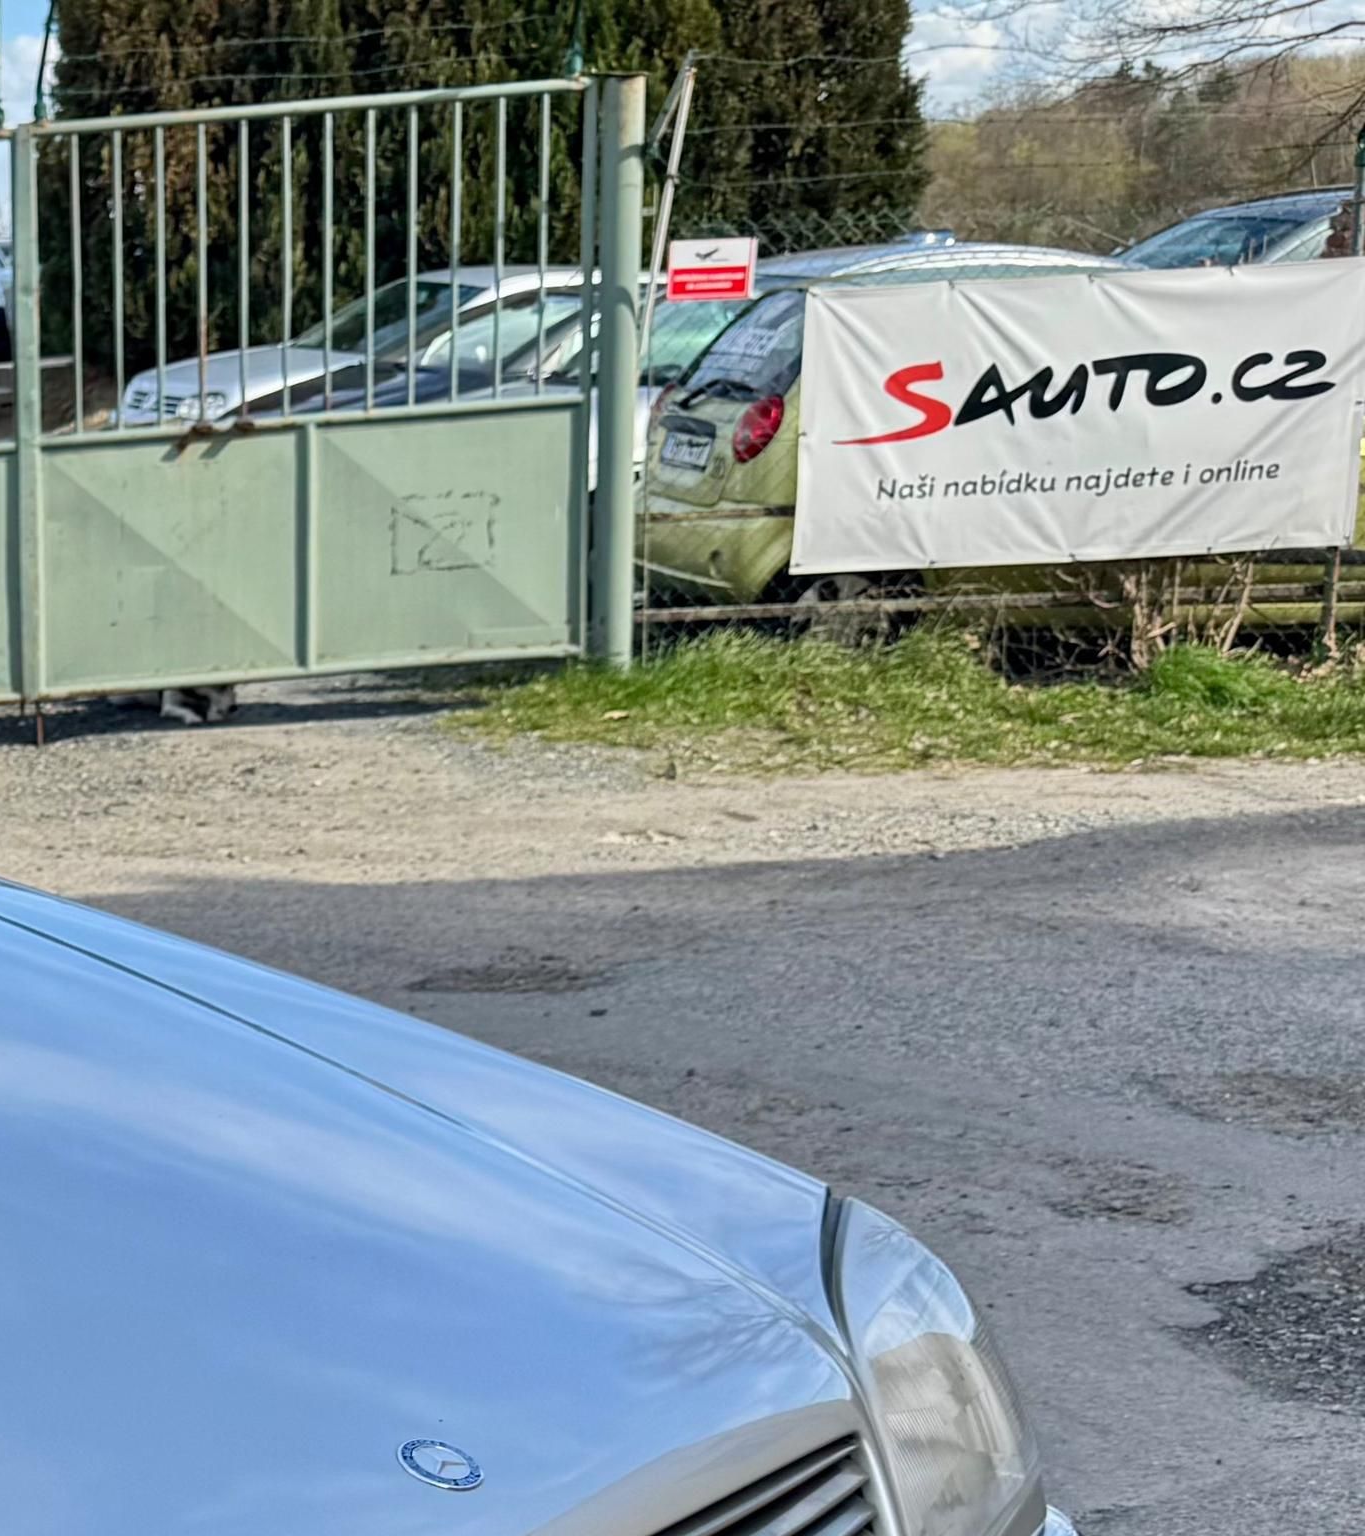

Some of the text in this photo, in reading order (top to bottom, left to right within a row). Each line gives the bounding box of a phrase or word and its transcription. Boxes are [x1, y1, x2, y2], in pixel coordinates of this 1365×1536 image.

[877, 459, 1281, 500] Naši nabídku najdete i online
